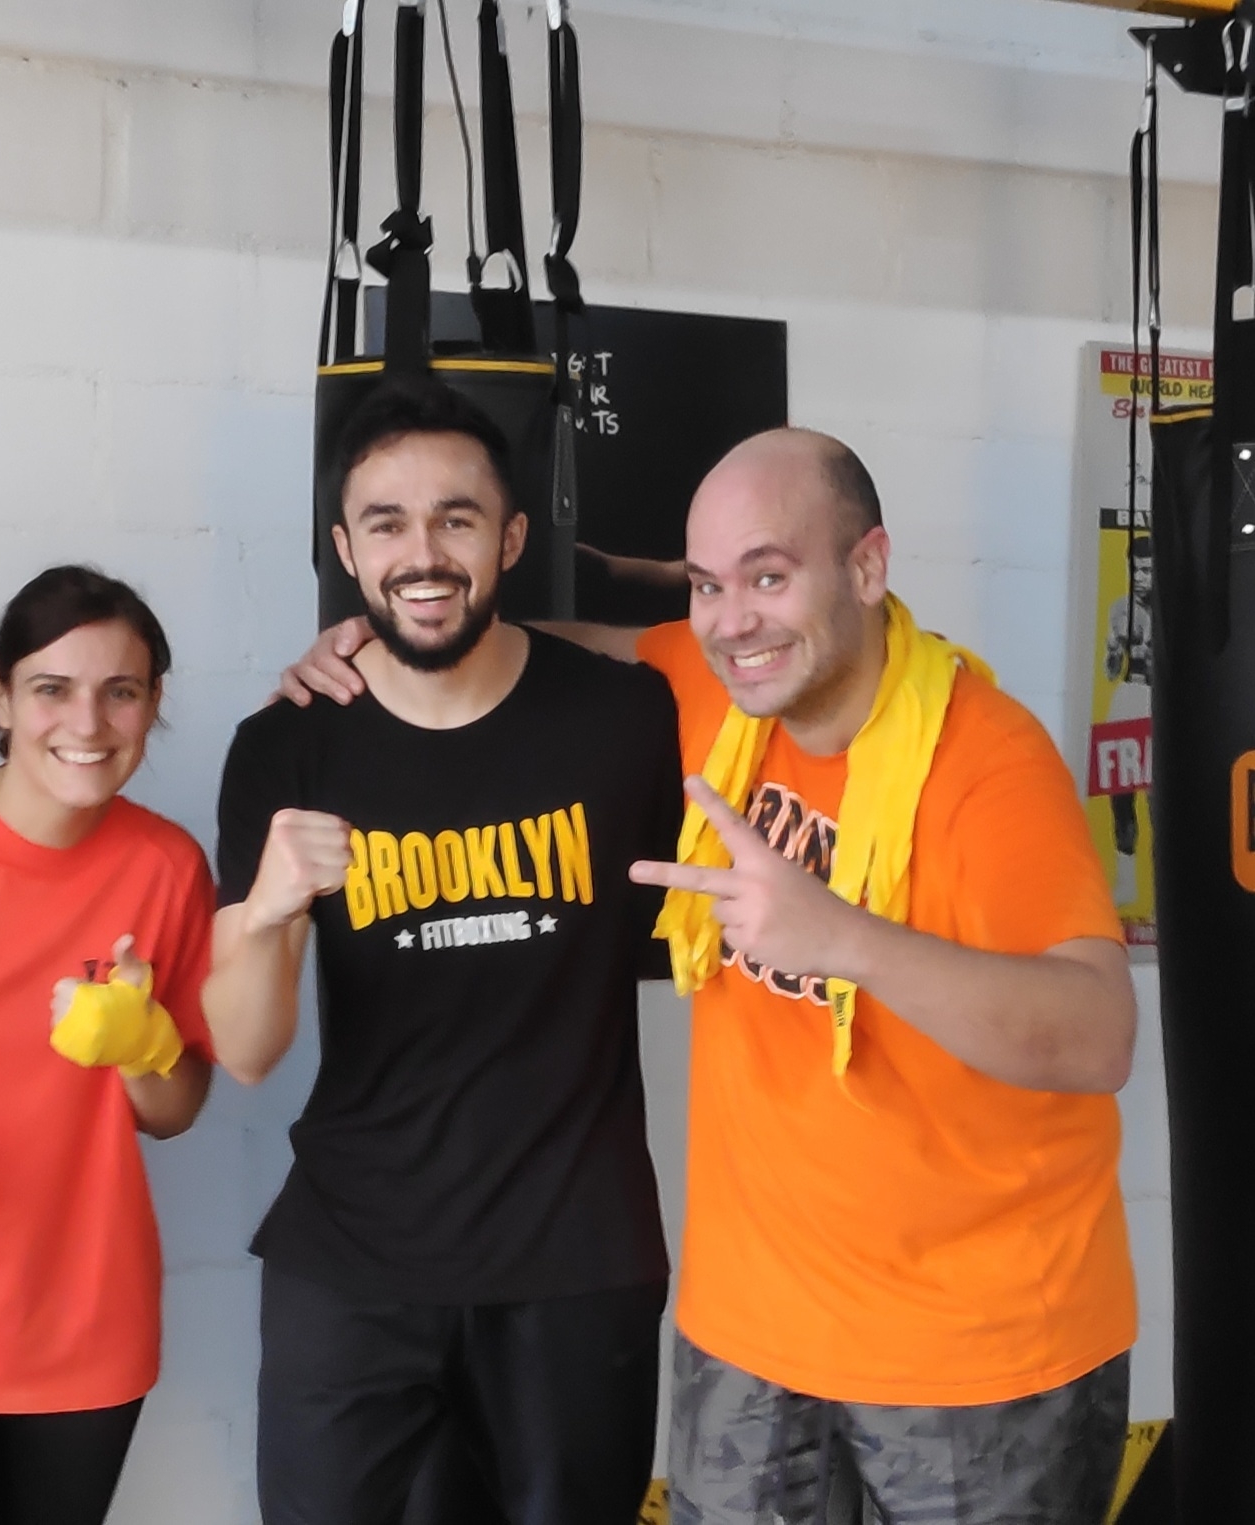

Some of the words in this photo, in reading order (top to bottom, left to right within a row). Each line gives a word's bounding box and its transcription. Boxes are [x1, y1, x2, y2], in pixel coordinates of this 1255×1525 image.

[1109, 354, 1134, 372] THE
[1139, 355, 1201, 377] GEATEST
[345, 802, 594, 931] BROOKLYN
[420, 910, 532, 951] FITBOXING
